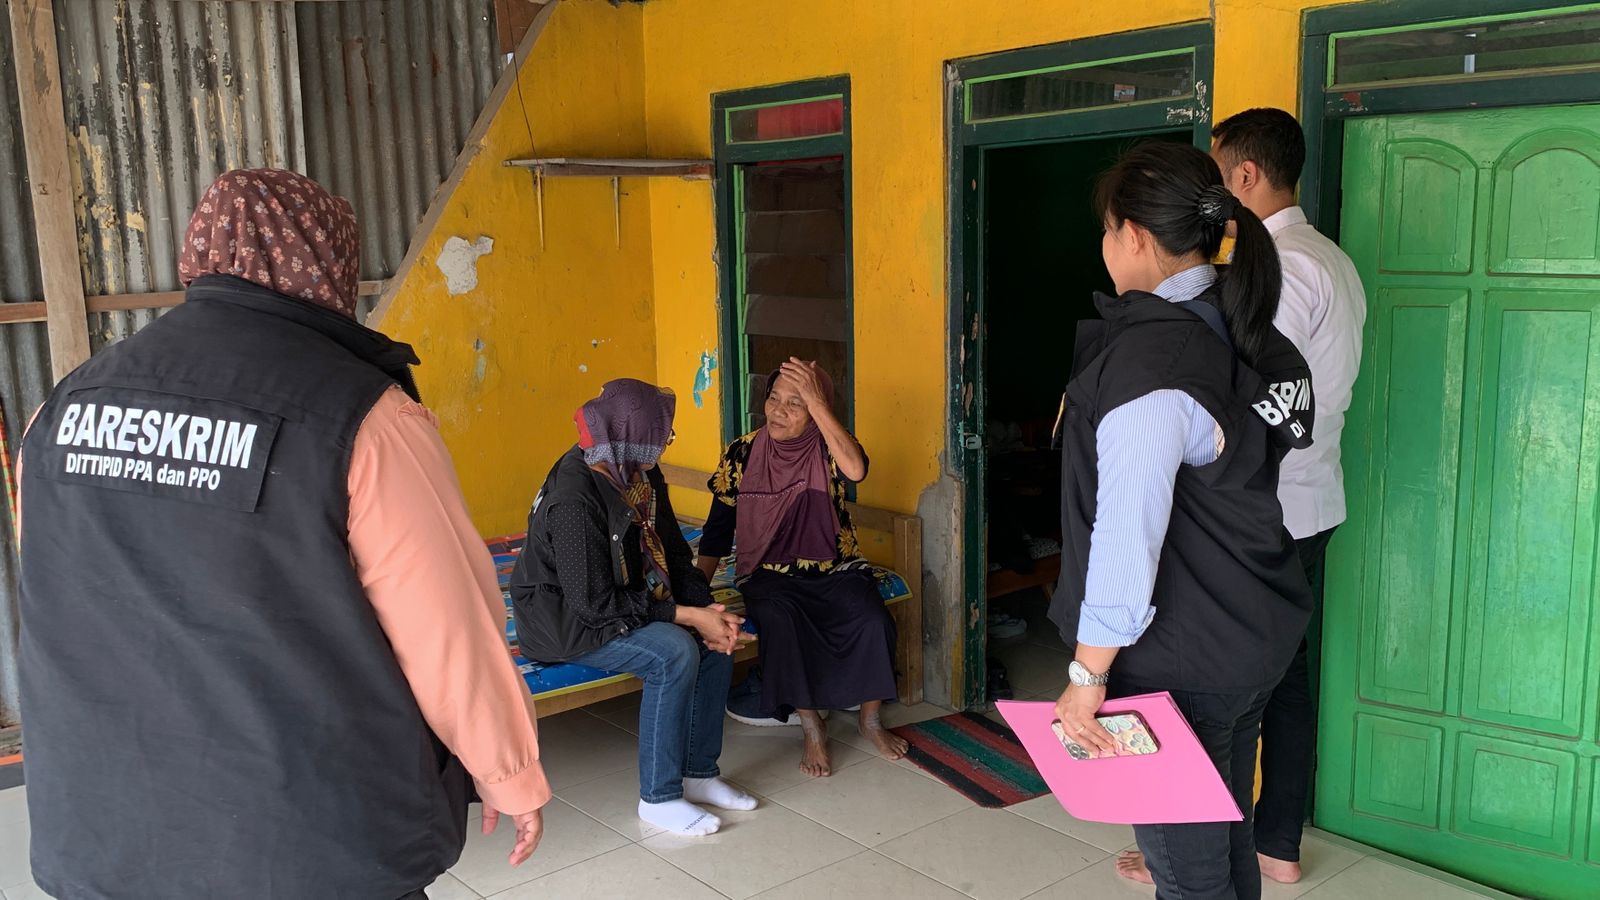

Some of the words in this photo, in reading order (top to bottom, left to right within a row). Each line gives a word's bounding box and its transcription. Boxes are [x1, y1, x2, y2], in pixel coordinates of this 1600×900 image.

[56, 403, 257, 468] BARESKRIM
[66, 453, 122, 477] DITTIPID
[123, 458, 153, 482] PPA
[156, 463, 185, 487] dan
[187, 467, 221, 491] PPO
